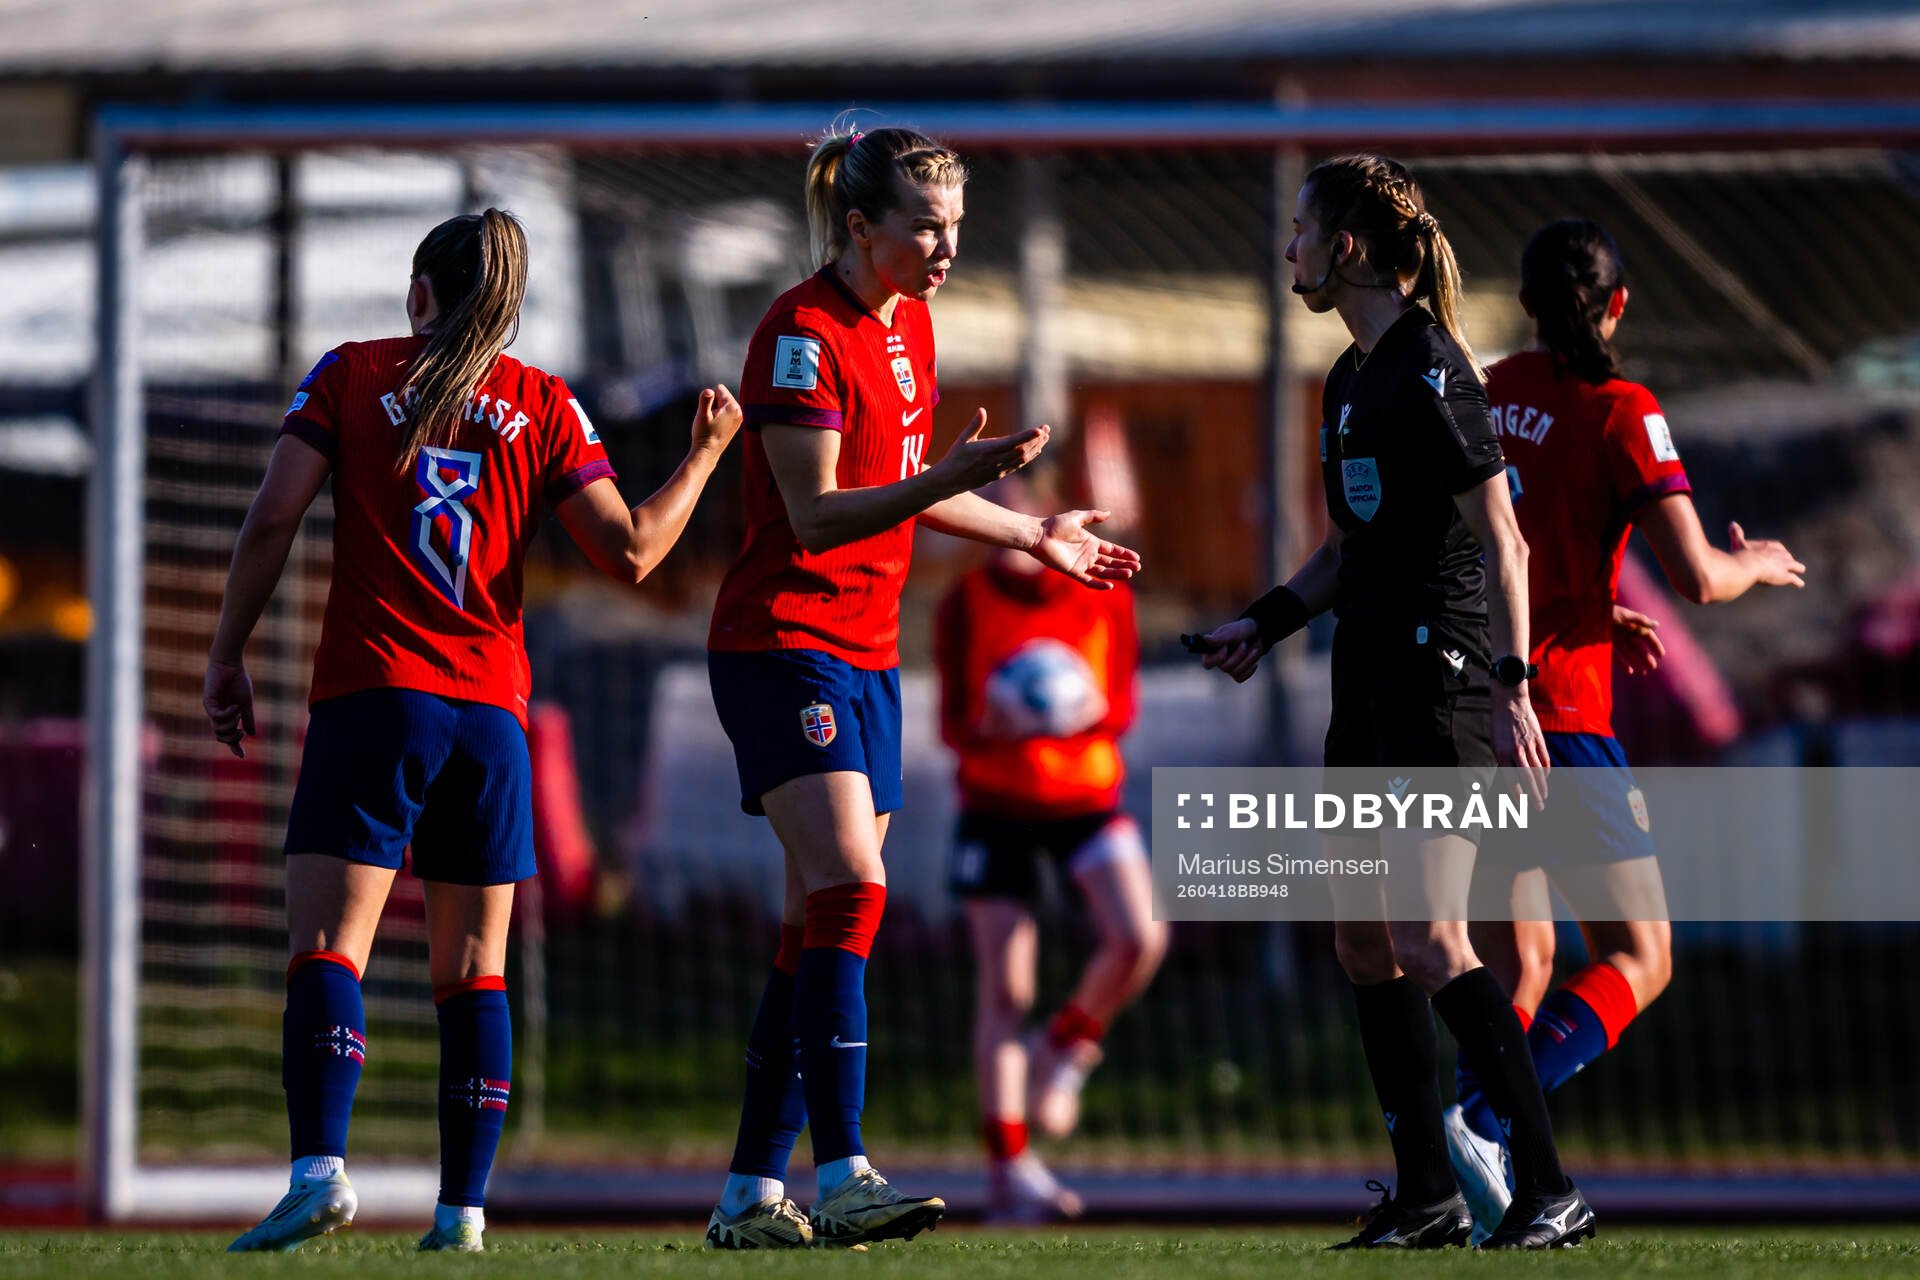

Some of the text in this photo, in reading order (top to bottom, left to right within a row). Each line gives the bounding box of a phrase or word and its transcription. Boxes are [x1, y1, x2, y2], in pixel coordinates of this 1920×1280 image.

[1489, 404, 1554, 445] NGEN
[901, 434, 924, 480] 14
[409, 446, 482, 611] 8
